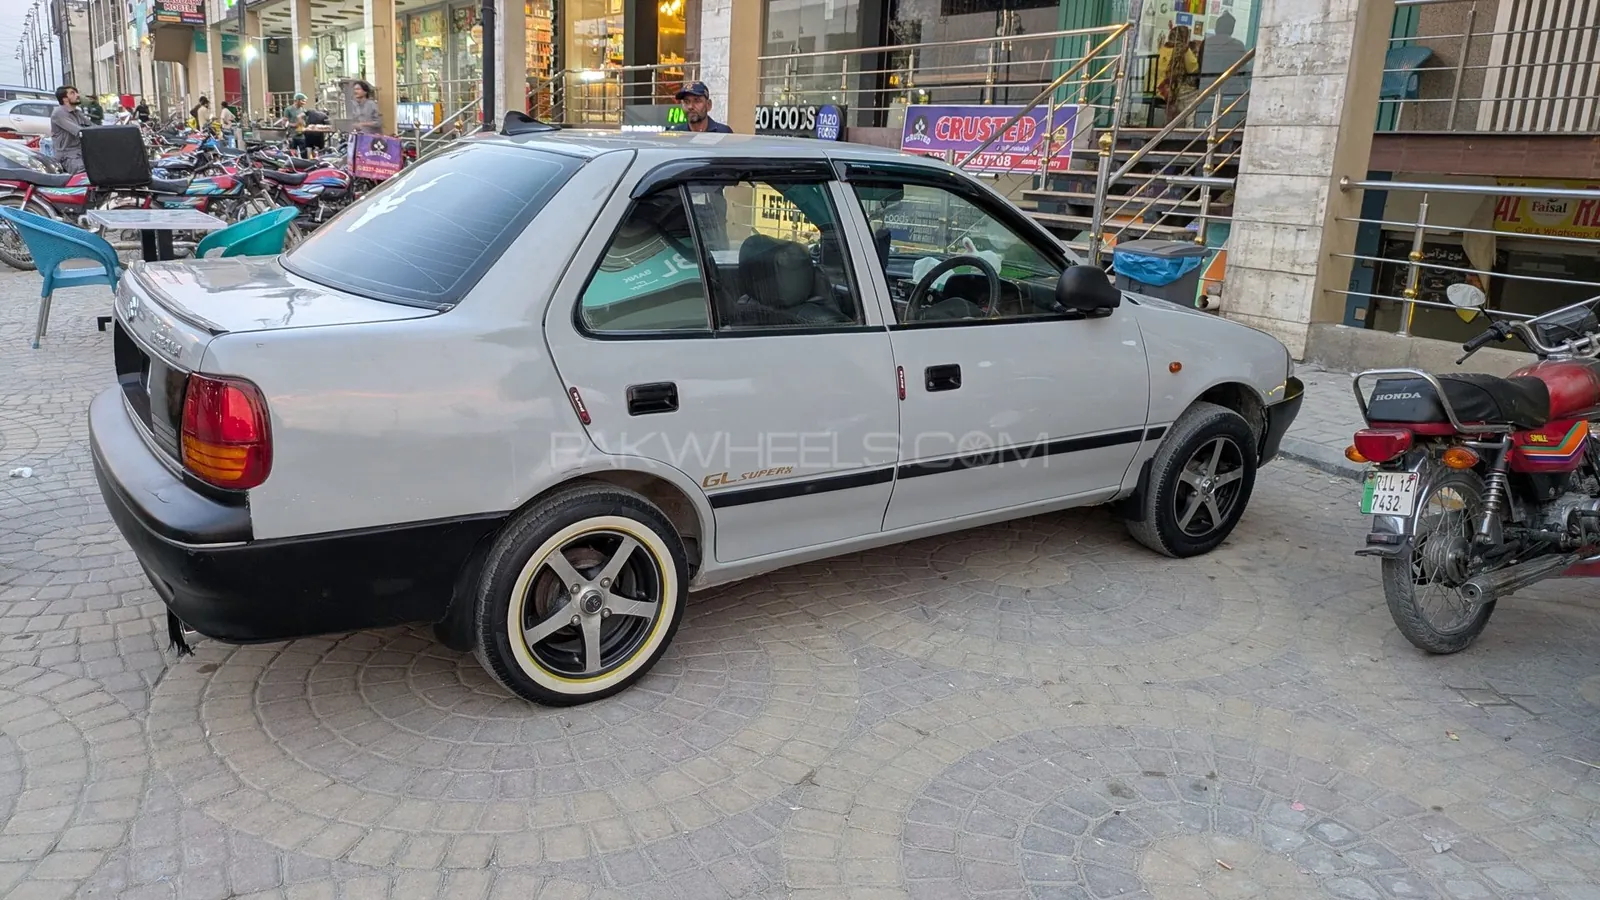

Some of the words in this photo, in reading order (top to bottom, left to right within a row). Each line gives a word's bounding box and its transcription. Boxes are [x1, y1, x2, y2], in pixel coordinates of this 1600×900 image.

[772, 106, 816, 130] FOODS
[819, 113, 837, 125] TAZO
[817, 127, 837, 139] FOODS
[935, 115, 1037, 143] CRUSTED
[1532, 201, 1567, 213] Faisal
[1375, 391, 1422, 401] HONDA
[1530, 434, 1549, 443] SMILE
[702, 471, 737, 489] GL
[1400, 479, 1412, 493] 12
[1372, 494, 1400, 512] 7432
